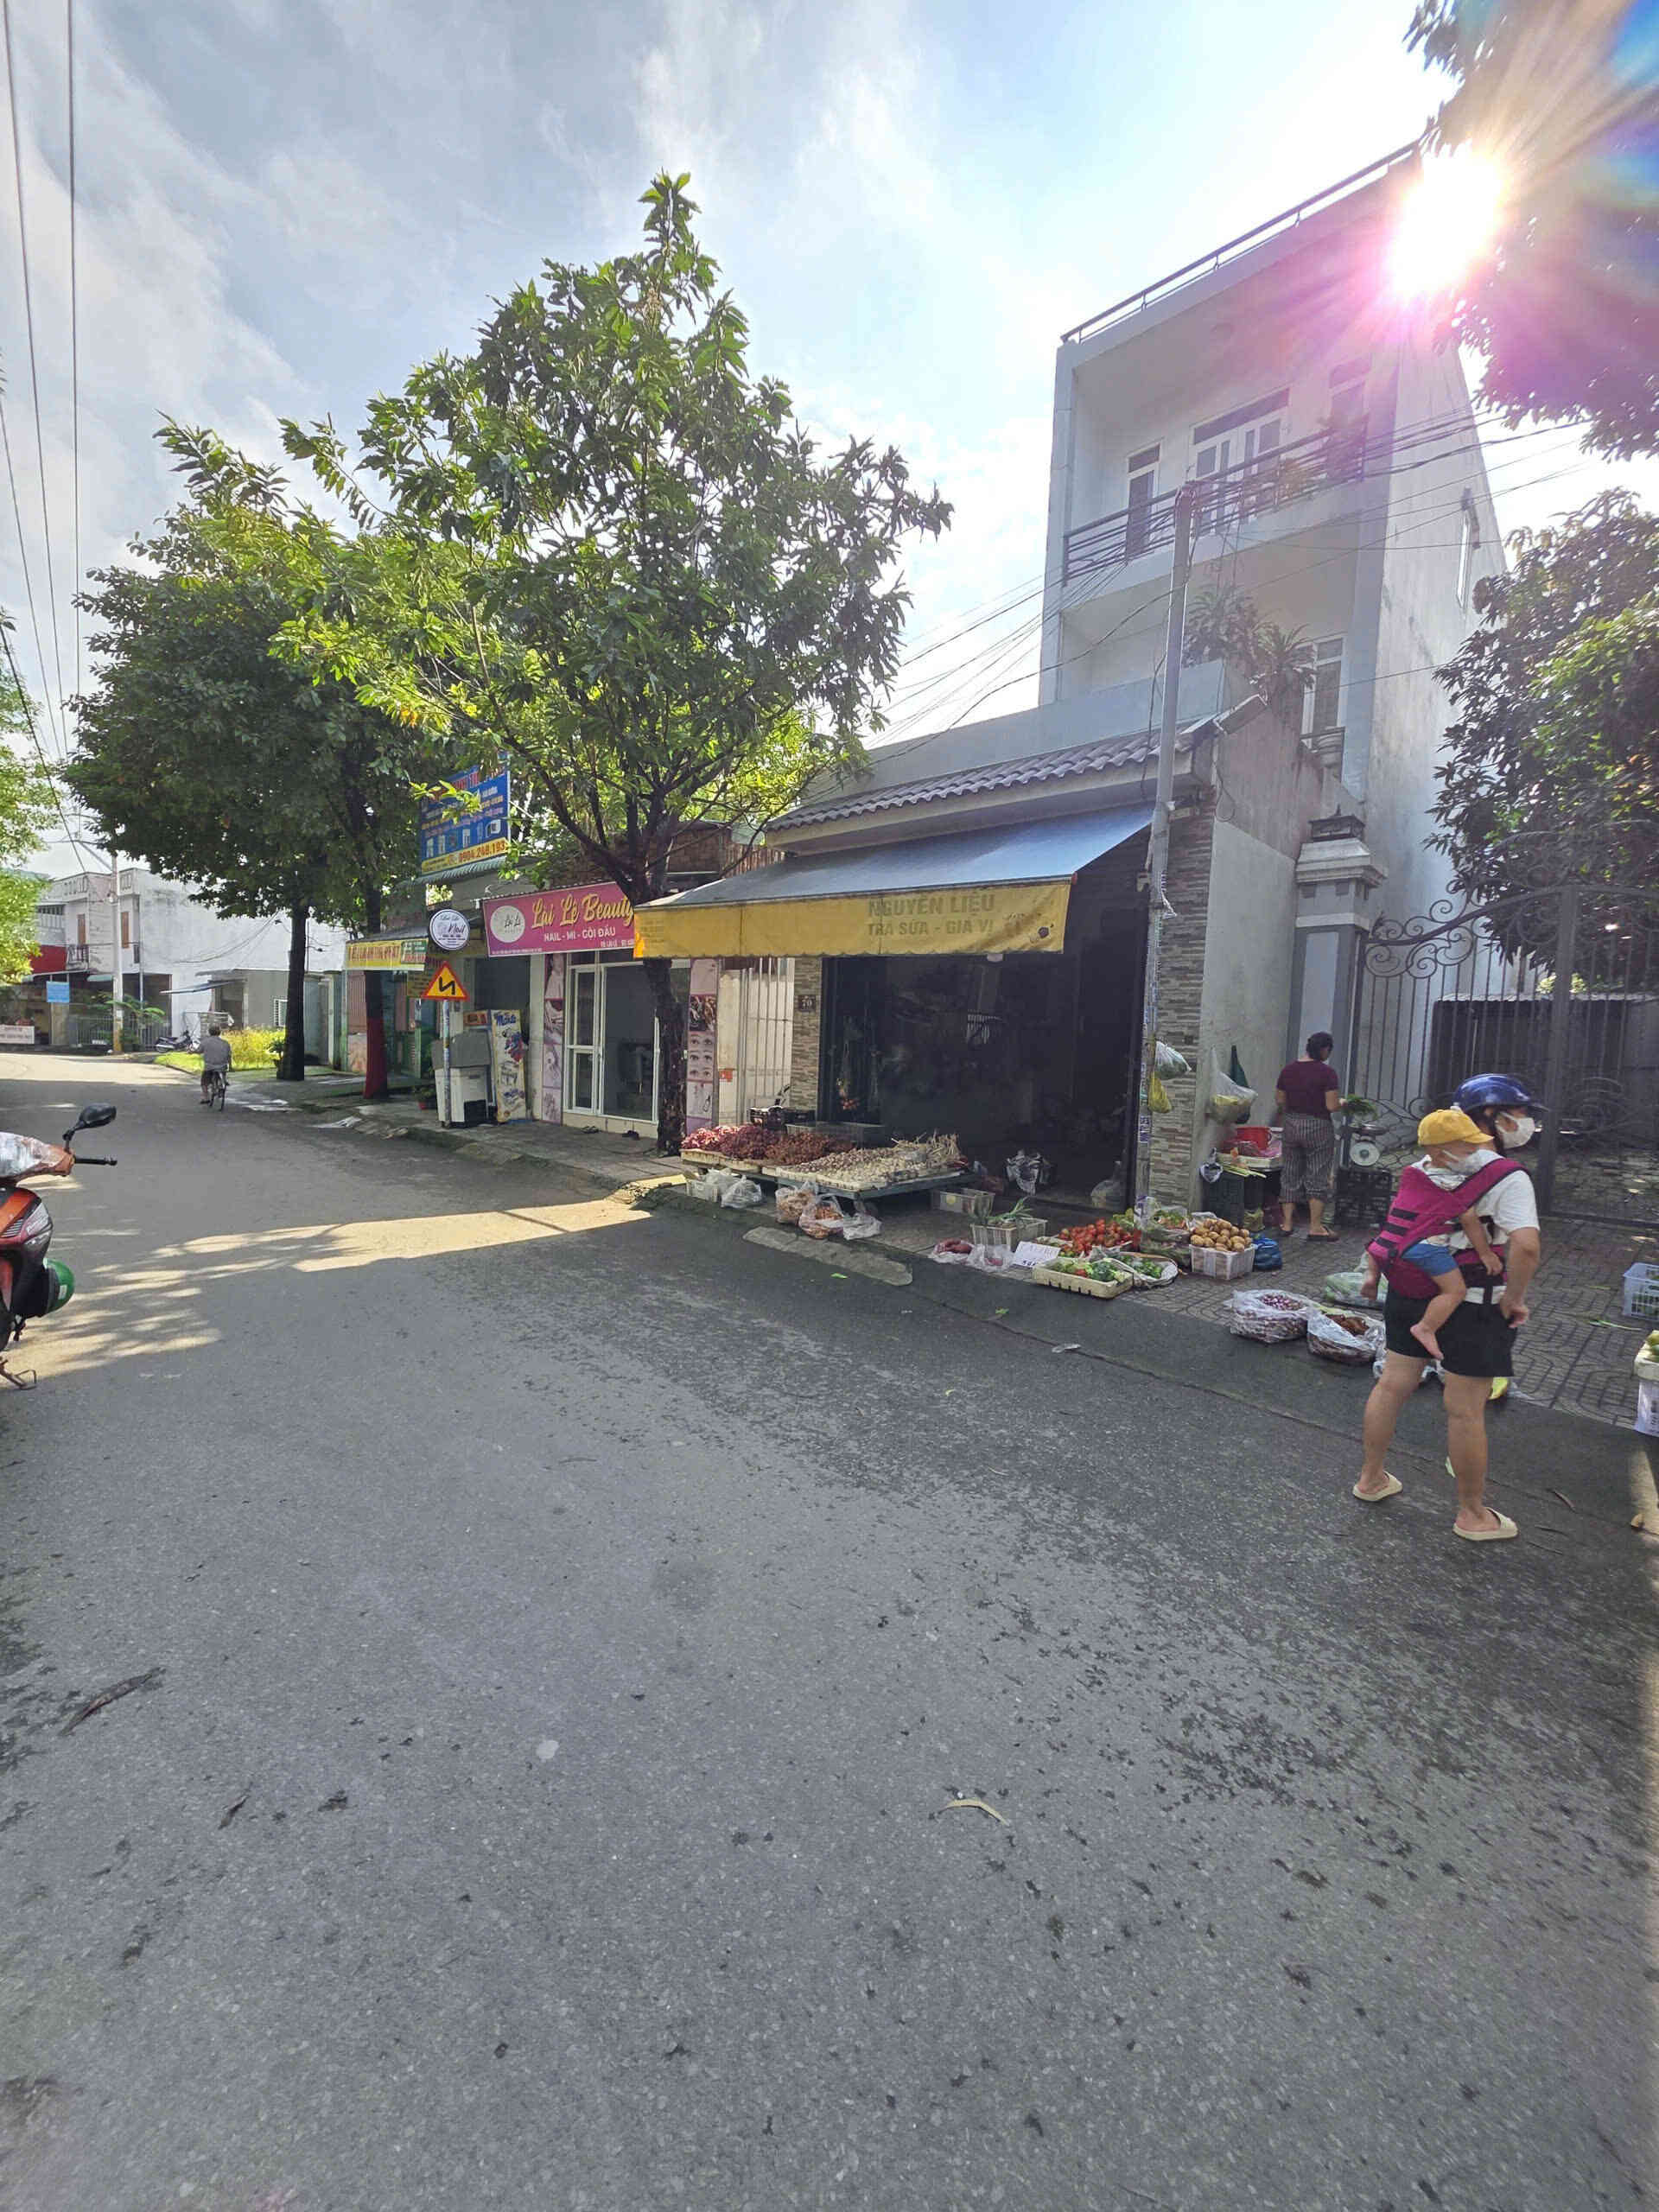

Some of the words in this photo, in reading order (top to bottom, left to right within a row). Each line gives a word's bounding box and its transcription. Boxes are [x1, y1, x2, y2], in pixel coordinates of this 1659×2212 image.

[582, 893, 634, 927] Beauty
[868, 894, 944, 917] NGUYÊN
[950, 892, 996, 918] LIỆU
[543, 931, 561, 942] NAIL
